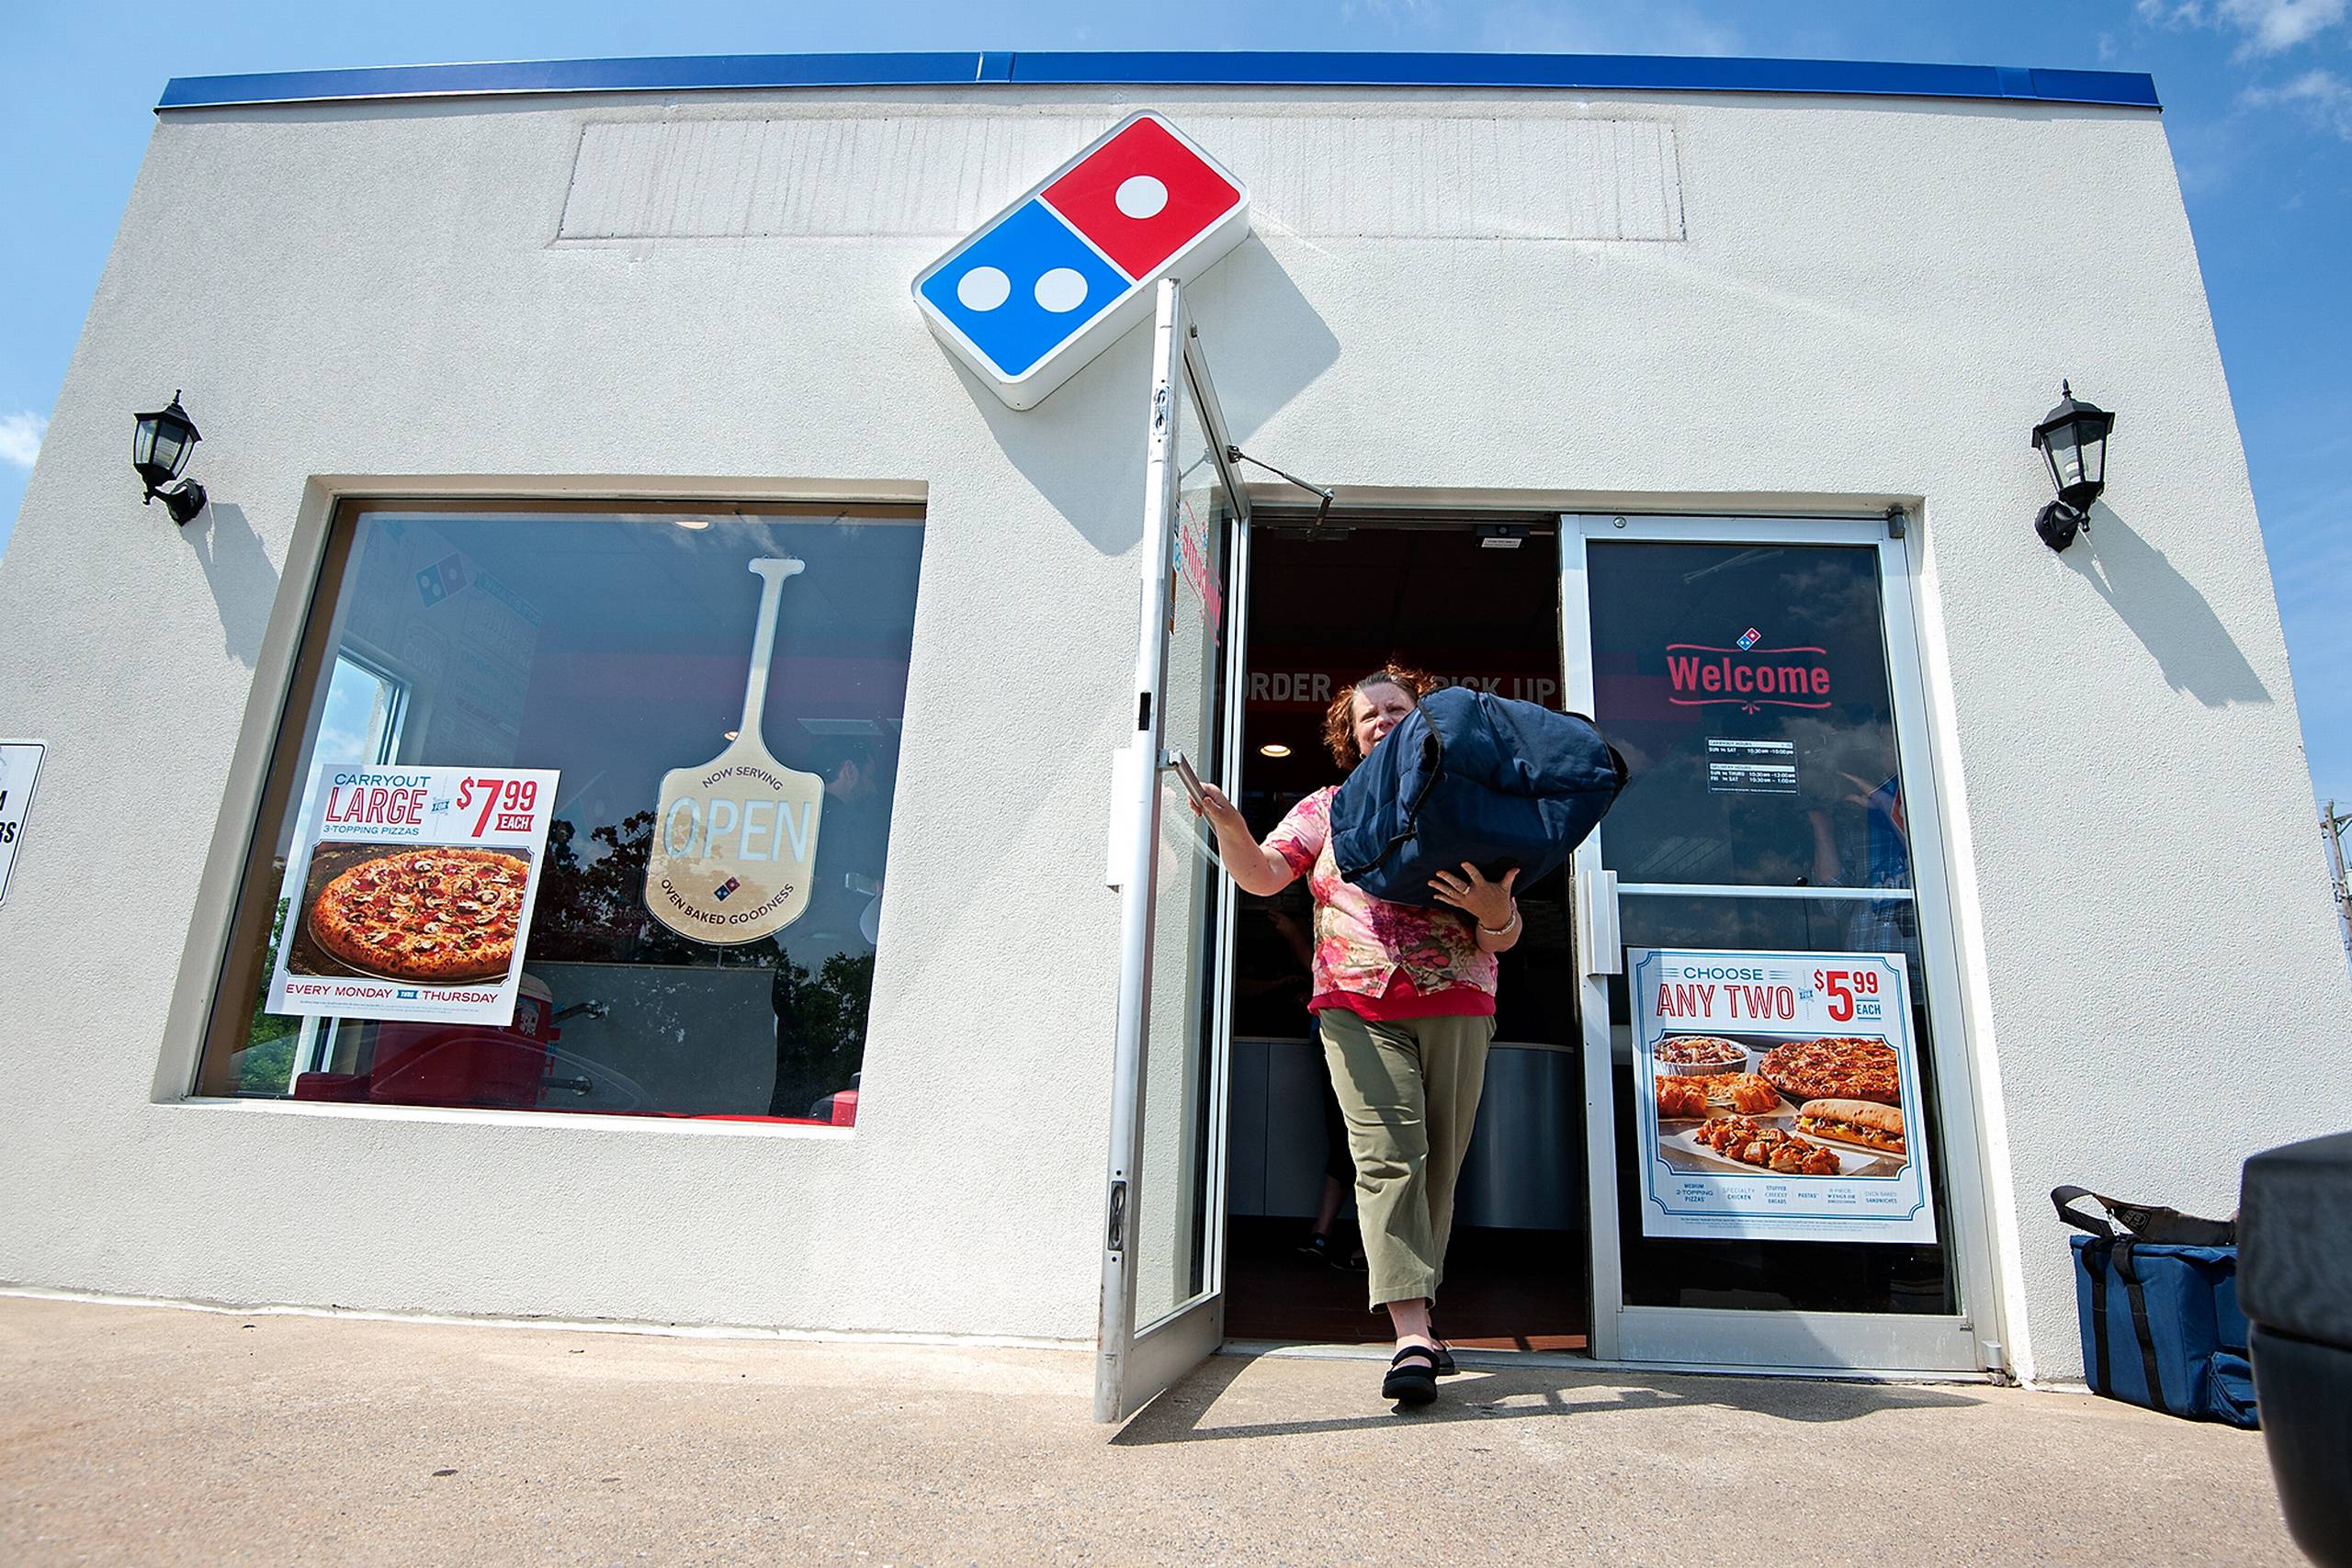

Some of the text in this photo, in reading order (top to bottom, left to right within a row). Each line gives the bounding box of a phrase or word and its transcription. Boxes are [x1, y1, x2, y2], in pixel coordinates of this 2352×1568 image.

[1667, 656, 1830, 694] Welcome
[1513, 677, 1556, 705] UP
[334, 773, 431, 788] CARRYOUT
[702, 766, 784, 791] NOW SERVING
[324, 786, 428, 825] LARGE
[323, 825, 420, 836] 3-TOPPING PIZZAS
[501, 815, 530, 830] EACH
[663, 796, 813, 863] OPEN
[661, 879, 795, 925] OVEN BAKED GOODNESS
[1683, 966, 1764, 981] CHOOSE
[286, 984, 332, 997] EVERY
[334, 986, 393, 998] MONDAY
[423, 990, 499, 1003] THURSDAY
[1656, 983, 1796, 1021] ANY TWO
[1856, 1003, 1882, 1016] EACH
